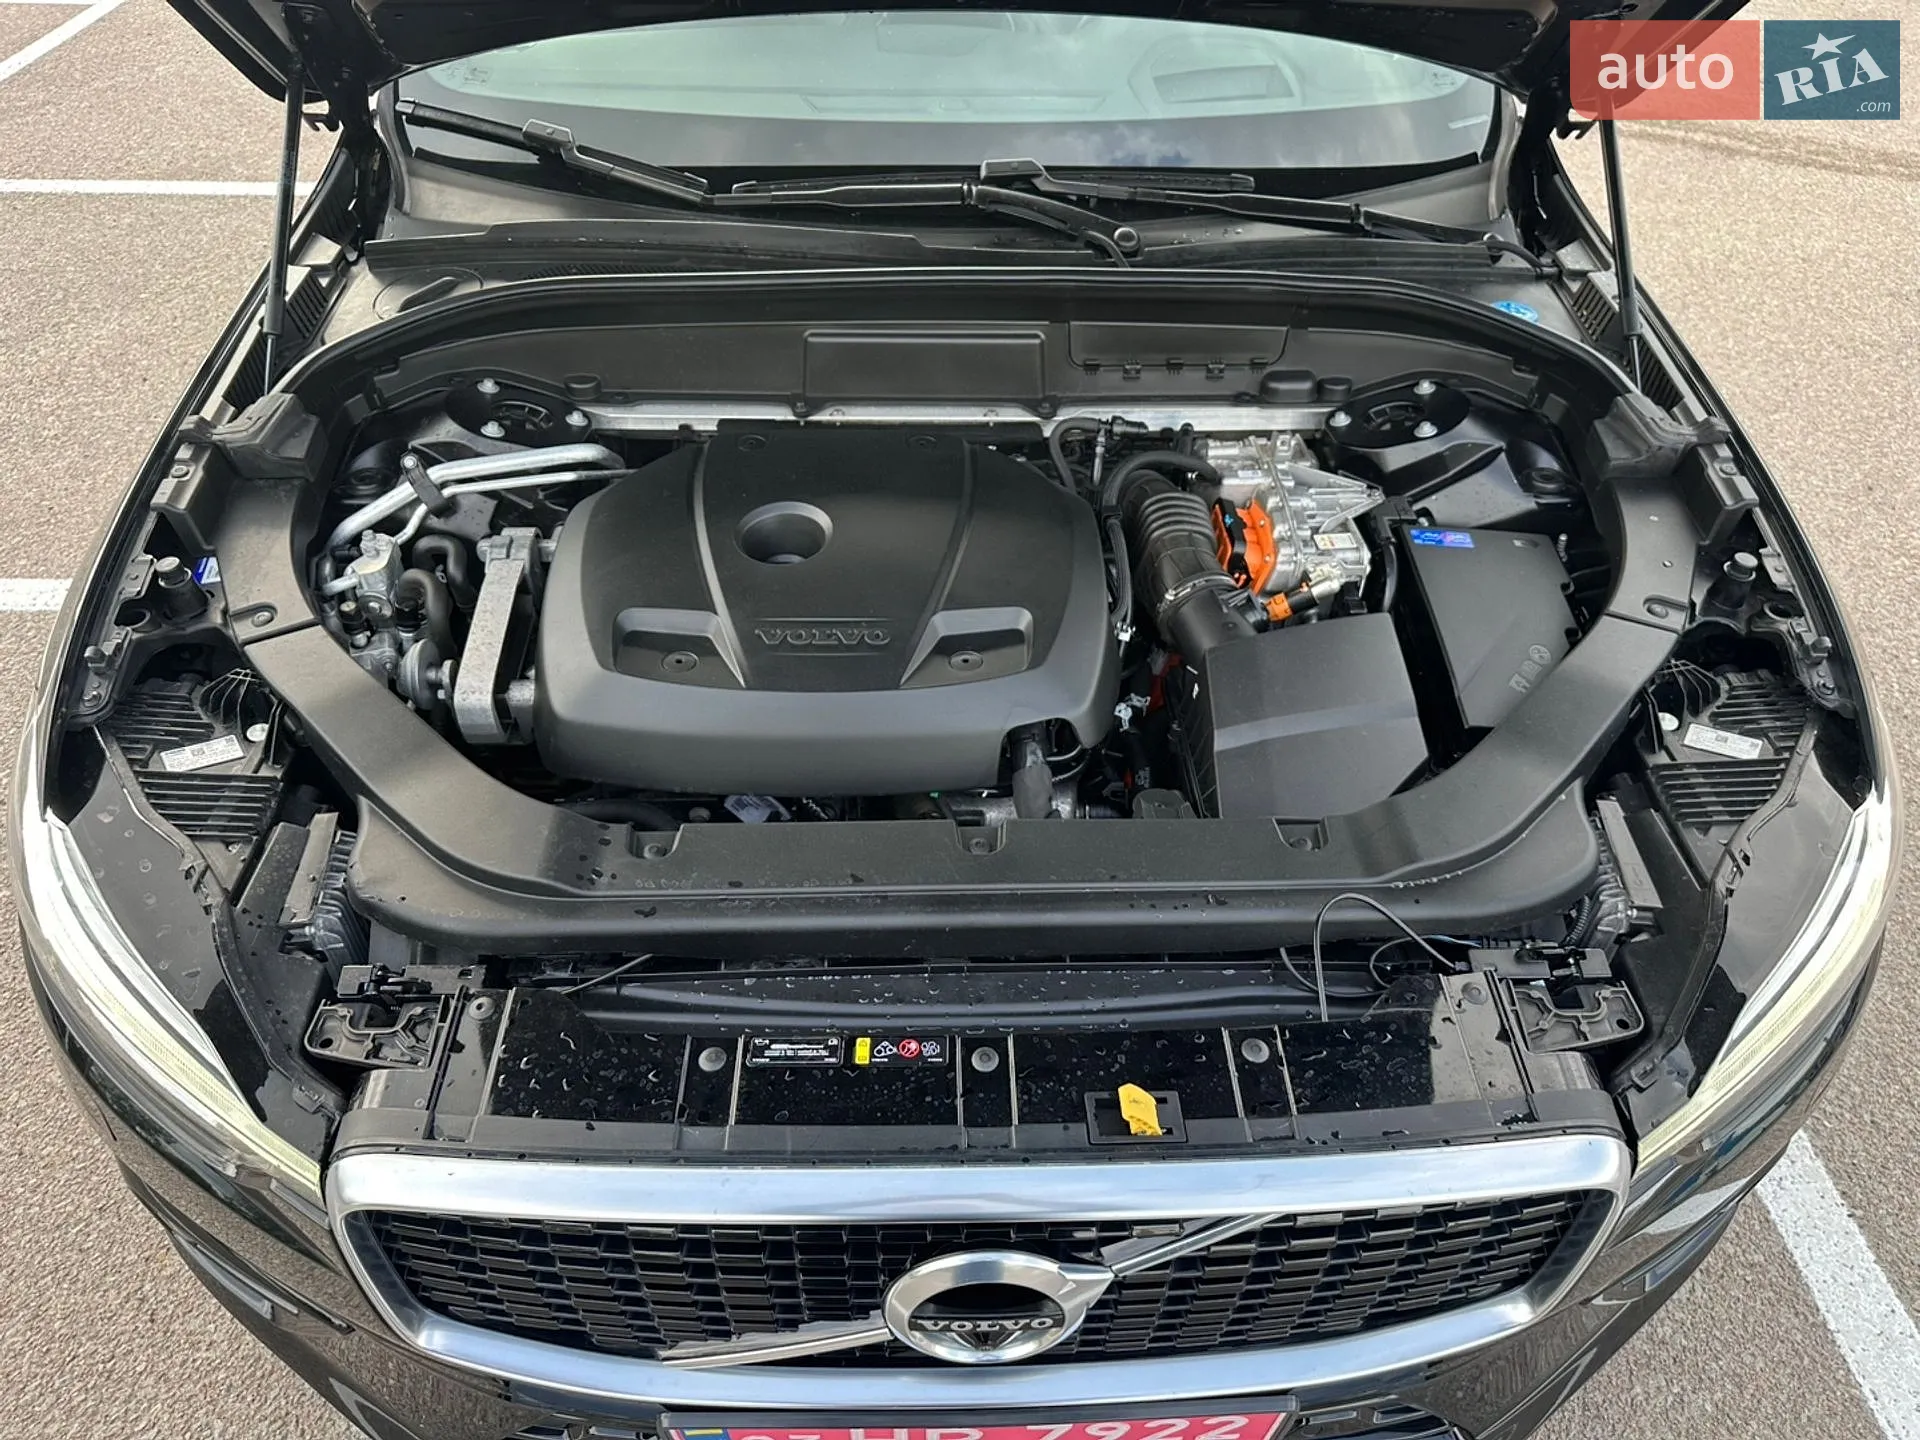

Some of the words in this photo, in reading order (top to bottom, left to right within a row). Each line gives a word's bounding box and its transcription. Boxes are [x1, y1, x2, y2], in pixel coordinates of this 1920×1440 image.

[754, 627, 892, 645] VOLVO
[916, 1317, 1054, 1331] VOLVO
[1026, 1415, 1250, 1440] 7922
